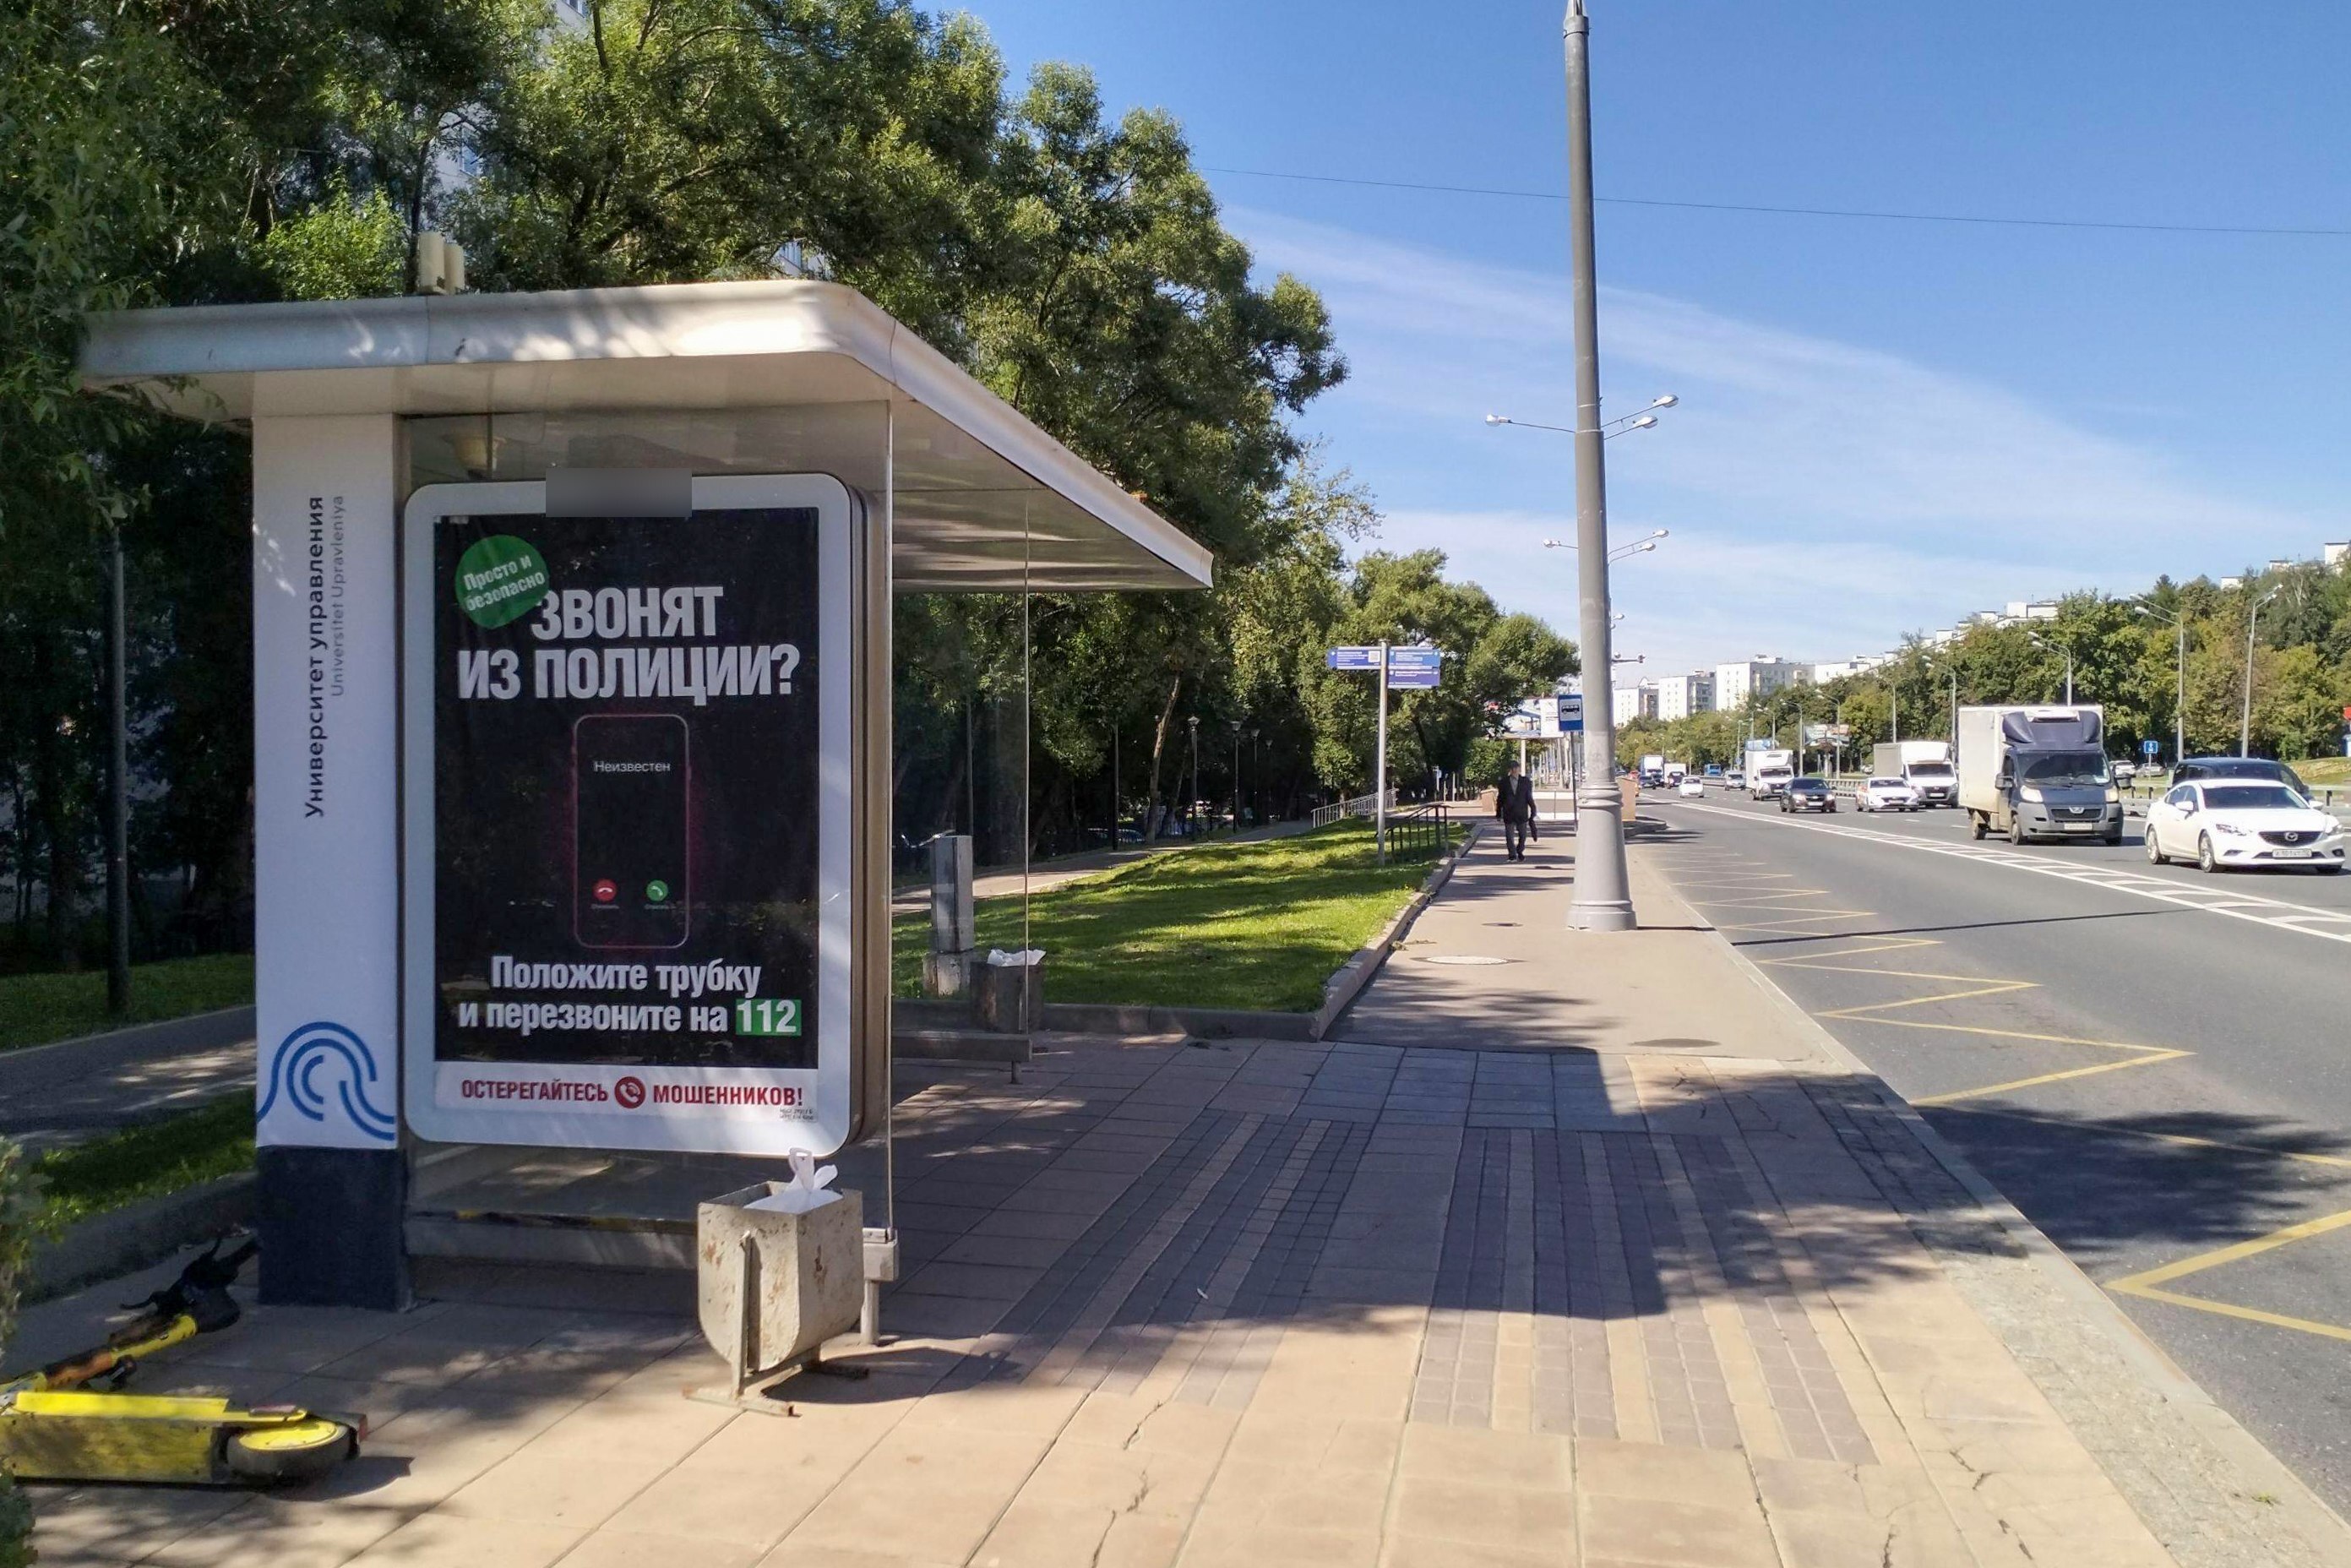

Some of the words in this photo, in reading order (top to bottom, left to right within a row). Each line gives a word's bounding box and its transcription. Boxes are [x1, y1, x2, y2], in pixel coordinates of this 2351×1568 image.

[330, 496, 346, 597] Upravleniya
[309, 497, 328, 650] управления
[464, 561, 518, 591] Просто
[520, 555, 532, 569] и
[465, 572, 546, 611] безопасно
[531, 586, 724, 640] ЗВОНЯТ
[330, 602, 345, 697] Universitet
[457, 650, 521, 700] ИЗ
[535, 643, 800, 706] ПОЛИЦИИ?
[305, 656, 328, 819] Университет
[593, 760, 672, 773] Неизвестен
[490, 955, 648, 990] Положите
[655, 957, 762, 999] трубку
[457, 1003, 479, 1027] и
[486, 1001, 682, 1036] перезвоните
[690, 1007, 728, 1032] на
[737, 999, 797, 1033] 112
[461, 1079, 608, 1102] ОСТЕРЕГАЙТЕСЬ
[653, 1085, 803, 1106] МОШЕННИКОВ!
